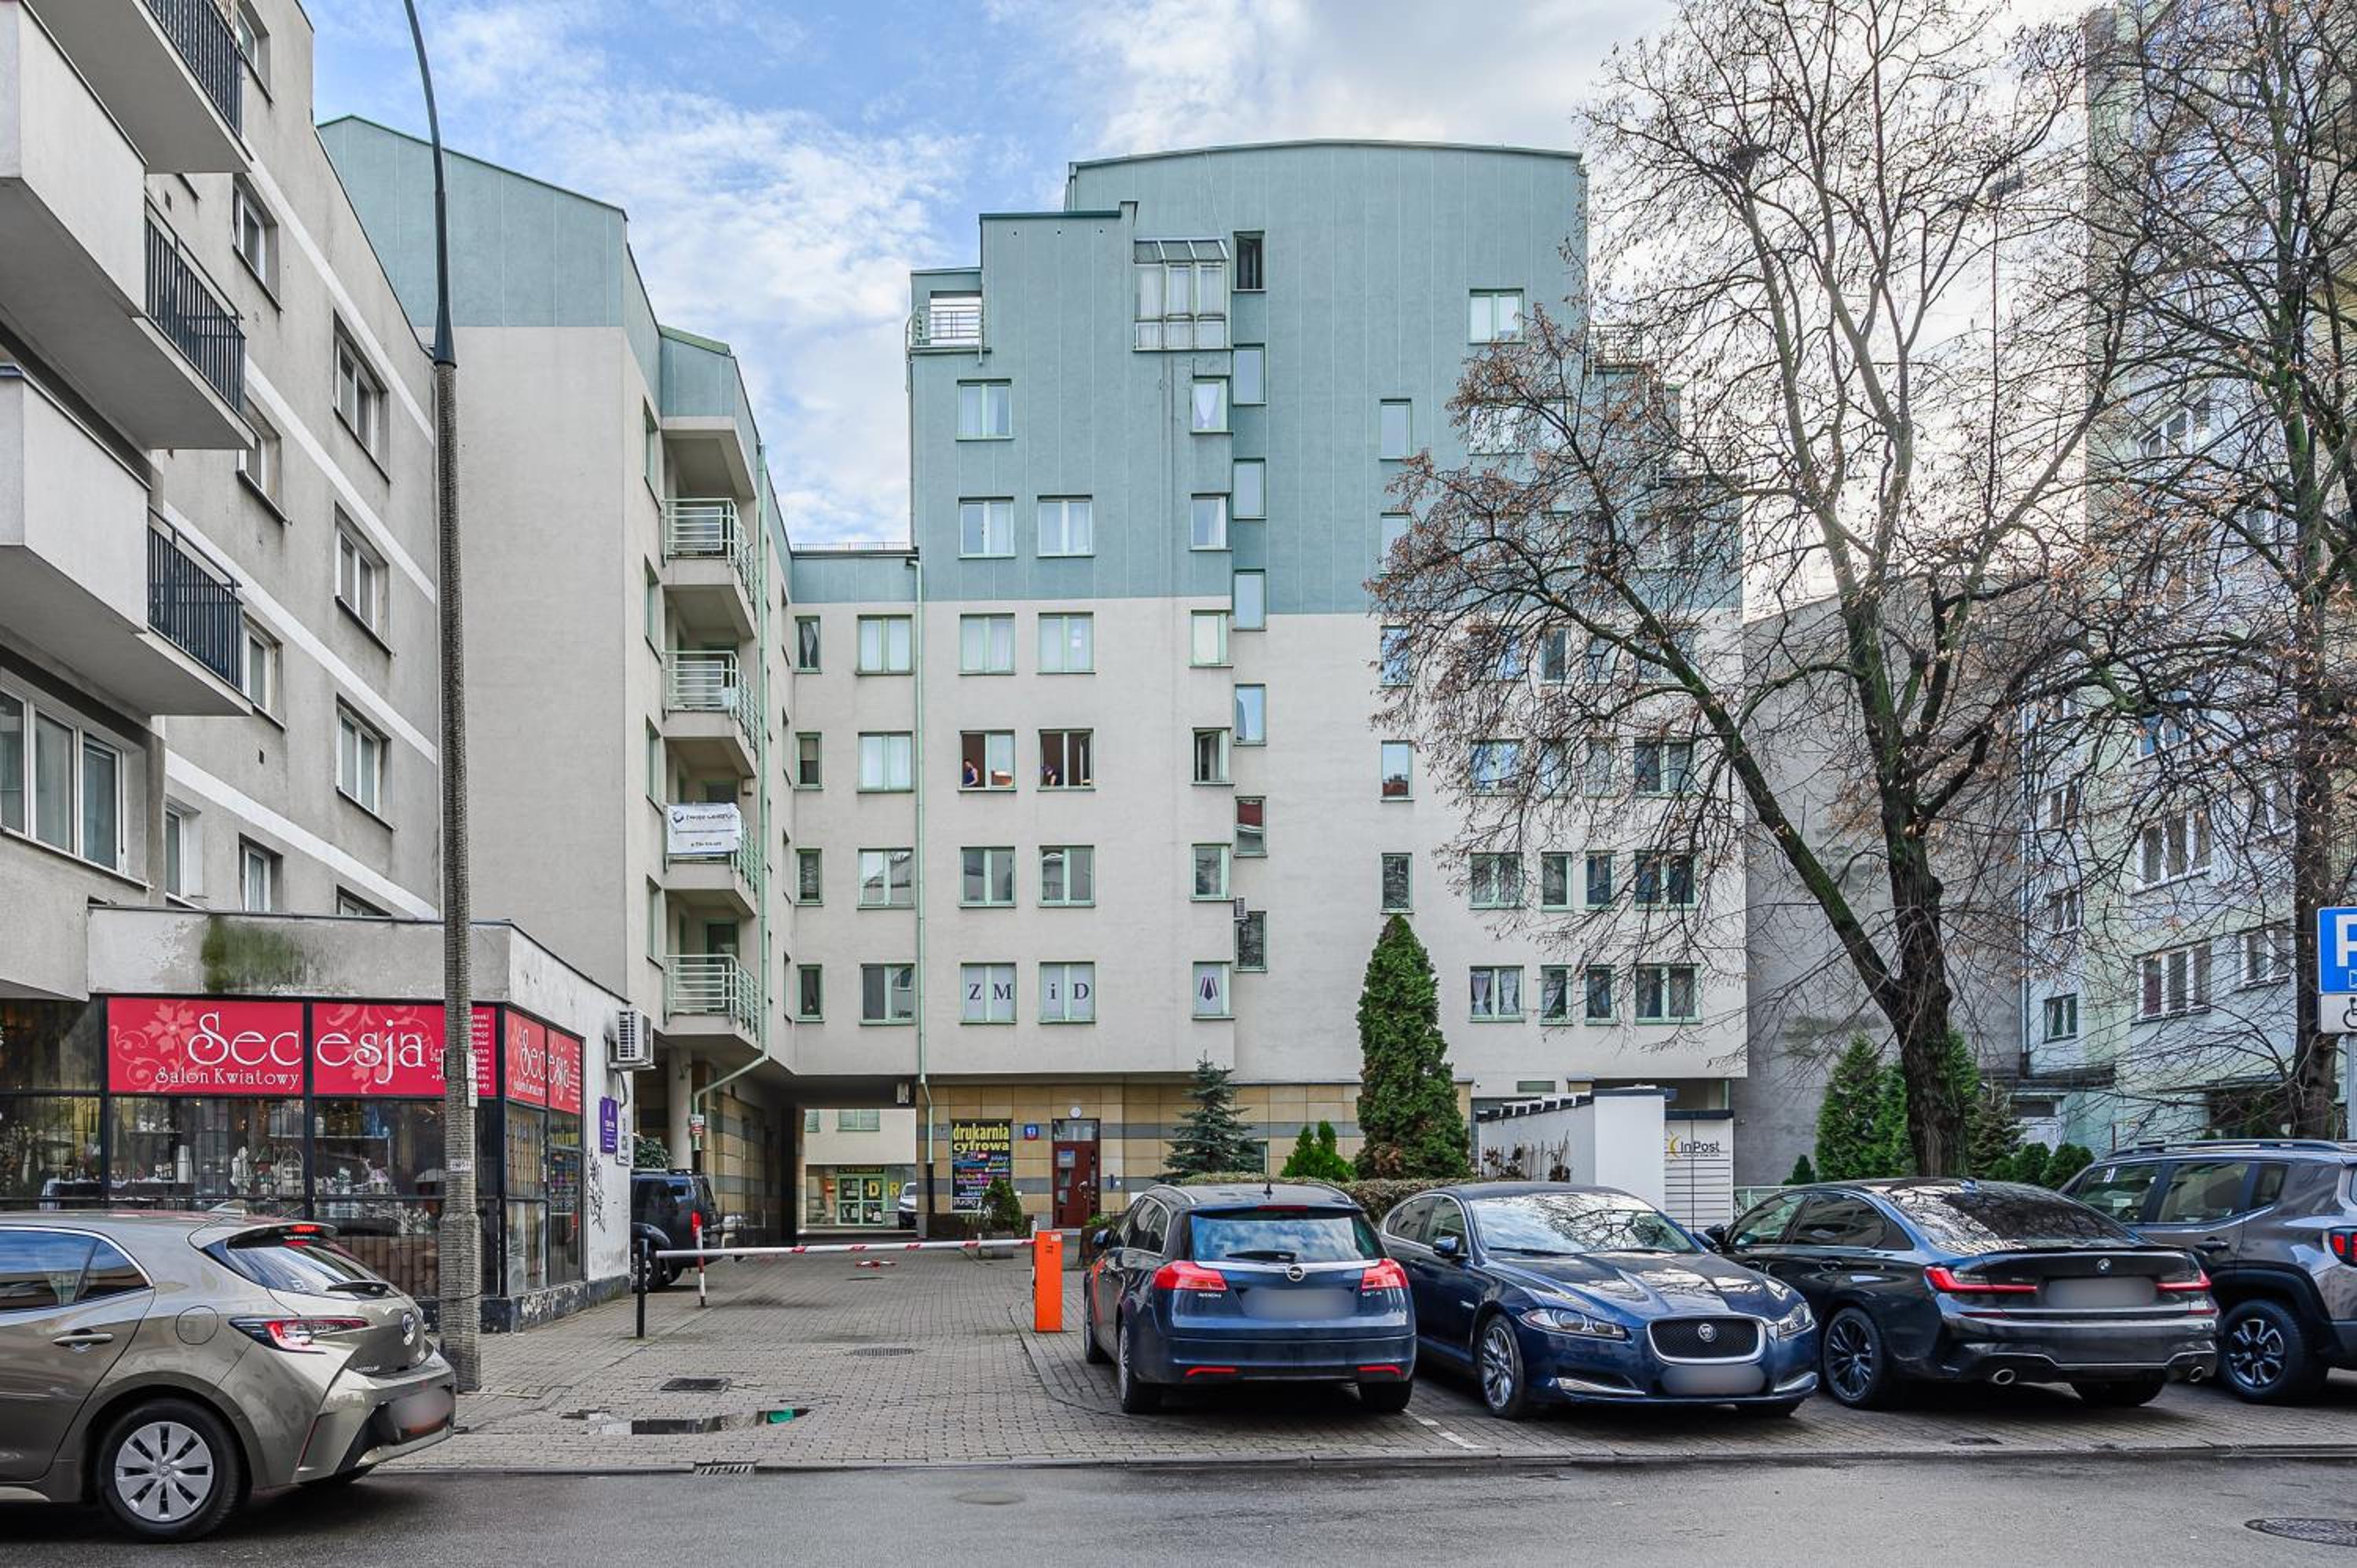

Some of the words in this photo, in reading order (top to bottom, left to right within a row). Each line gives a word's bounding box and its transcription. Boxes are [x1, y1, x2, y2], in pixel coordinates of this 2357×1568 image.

[155, 1066, 209, 1084] Salon
[214, 1068, 300, 1090] Kwiatowy
[953, 1122, 1010, 1140] drukarnia
[953, 1140, 1010, 1153] cyfrowa
[1681, 1141, 1721, 1152] InPost
